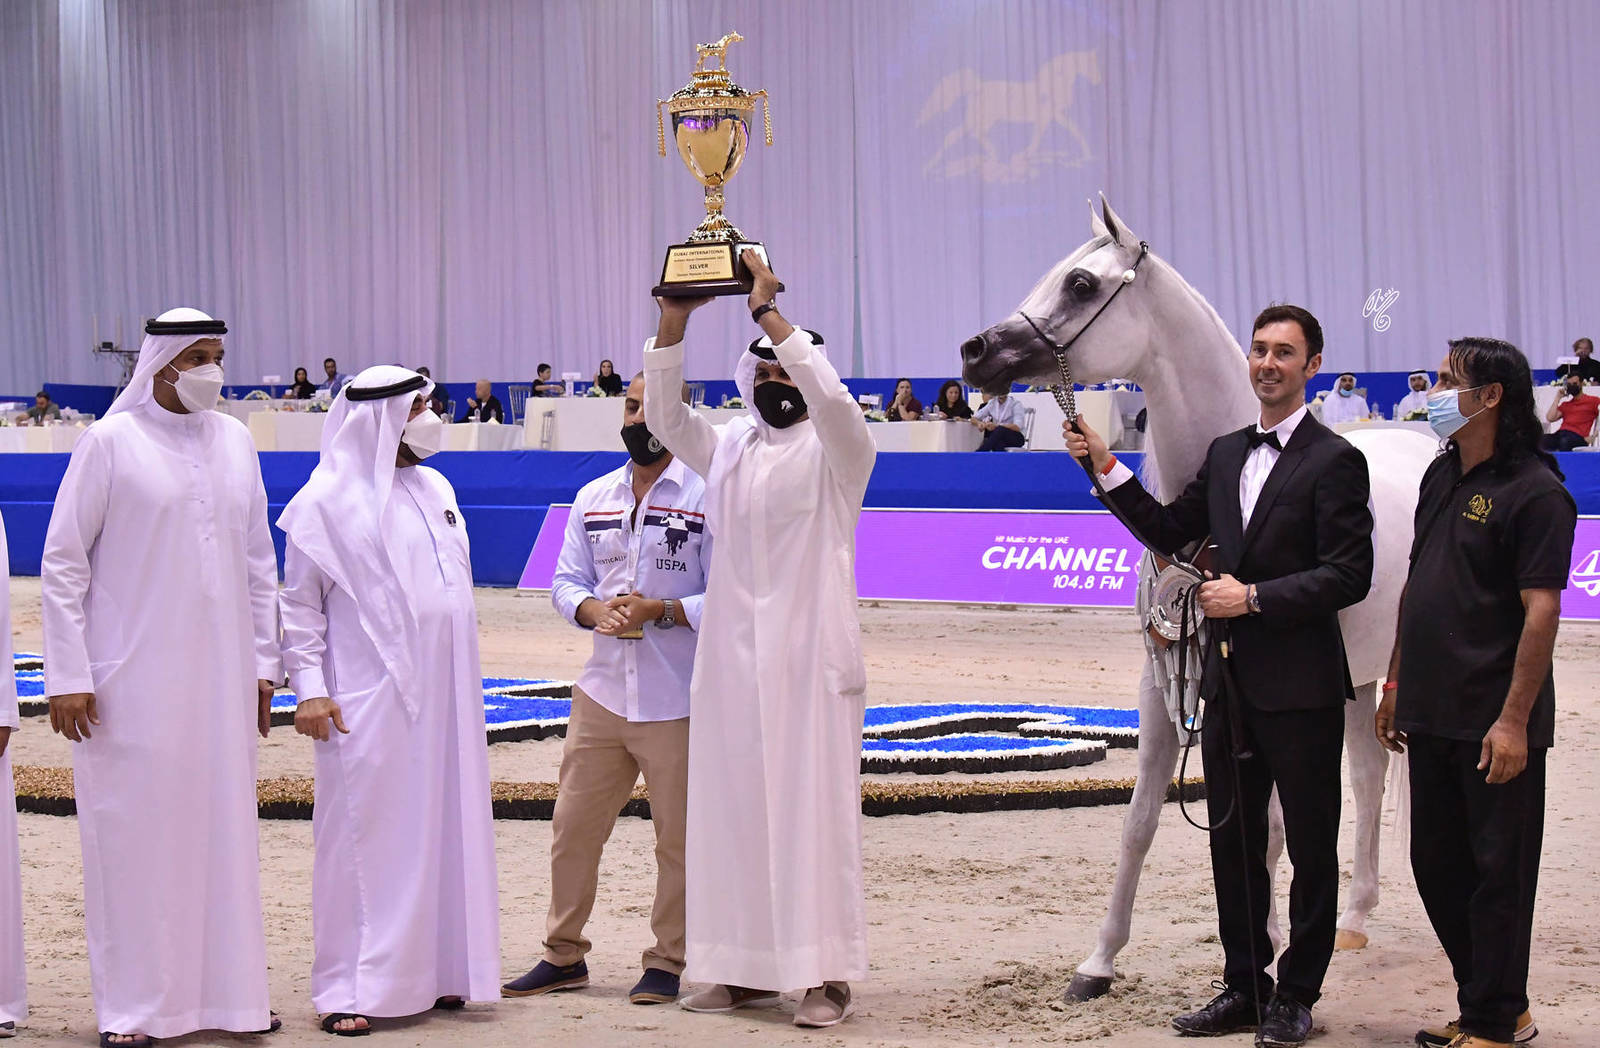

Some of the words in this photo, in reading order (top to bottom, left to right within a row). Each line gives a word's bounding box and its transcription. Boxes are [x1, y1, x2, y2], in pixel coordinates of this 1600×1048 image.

[1040, 536, 1053, 544] the
[1054, 536, 1070, 544] UAE
[656, 558, 687, 572] USPA
[981, 545, 1131, 573] CHANNEL
[1053, 574, 1095, 589] 104.8
[1099, 575, 1124, 590] FM
